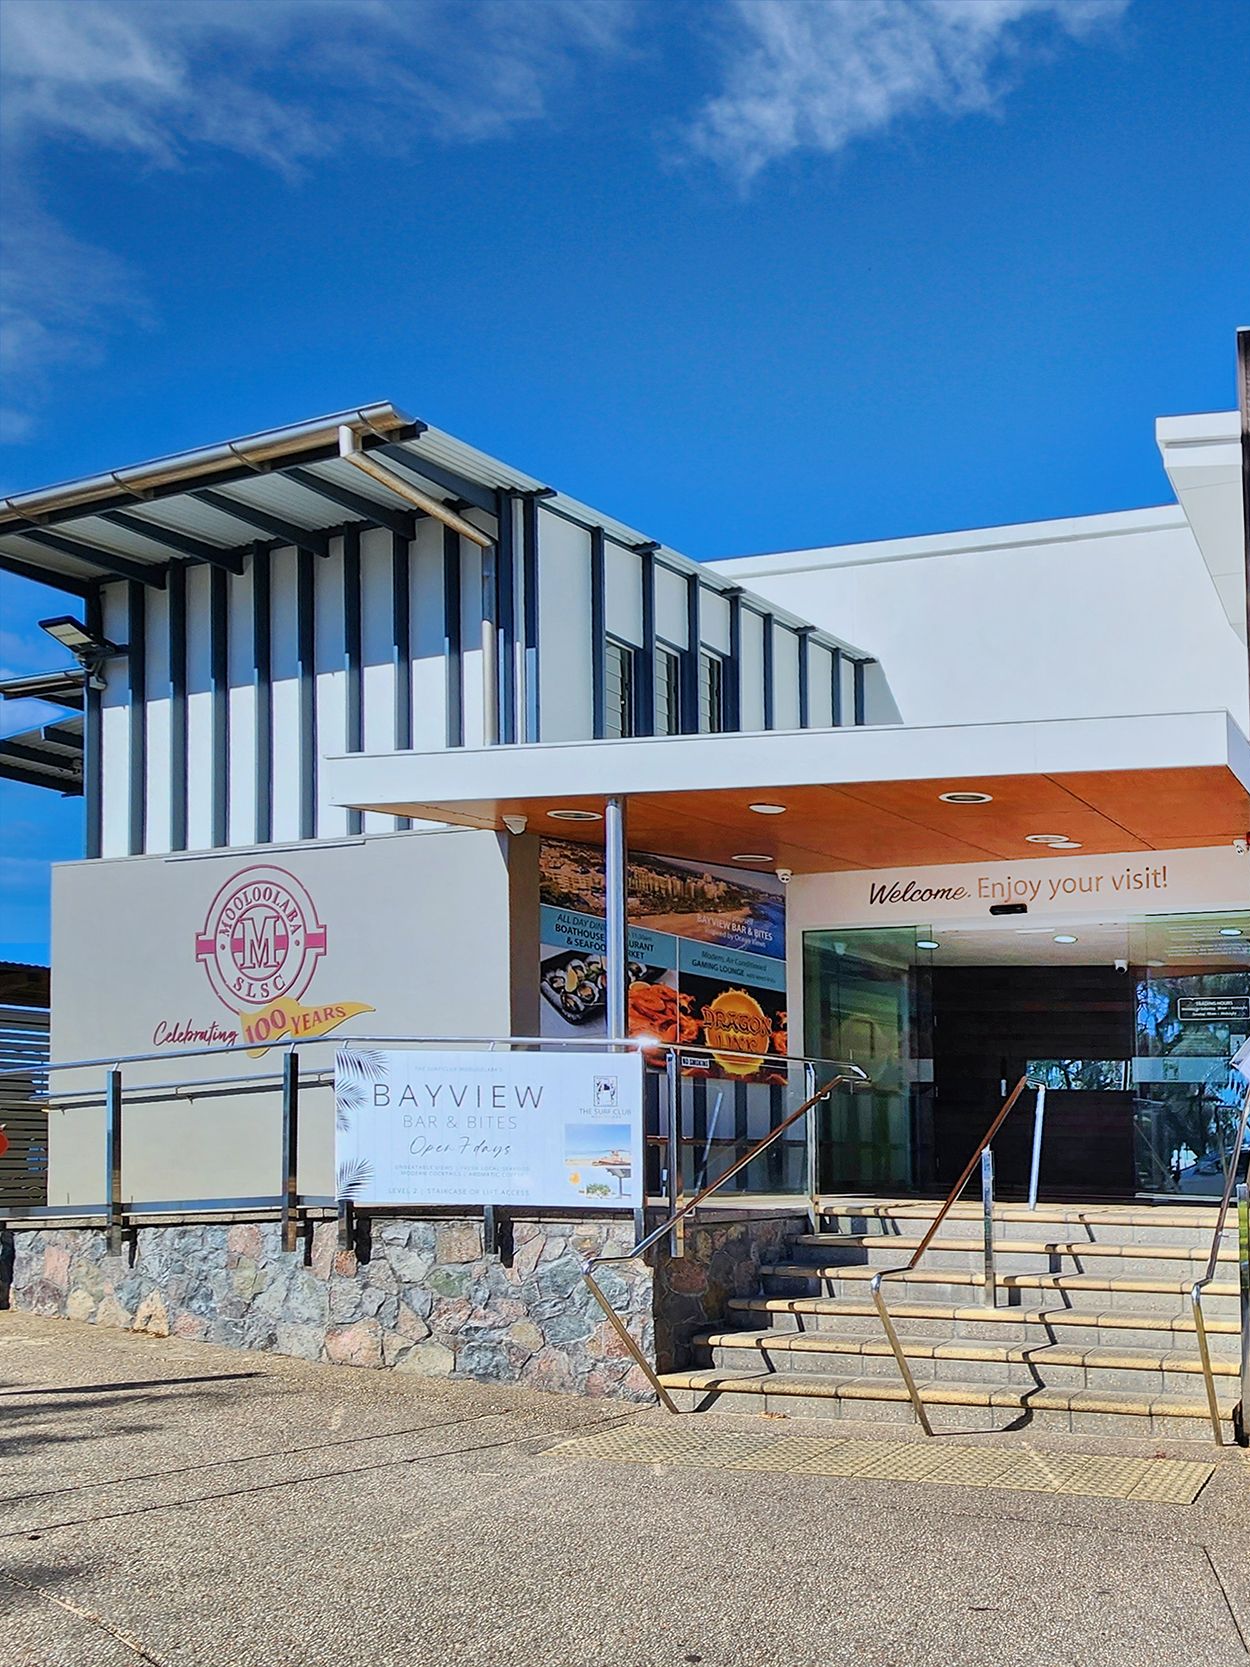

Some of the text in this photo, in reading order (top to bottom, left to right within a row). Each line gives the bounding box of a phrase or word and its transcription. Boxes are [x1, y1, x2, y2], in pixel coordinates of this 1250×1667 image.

[978, 876, 1041, 902] Enjoy
[1048, 875, 1103, 900] your
[1112, 866, 1167, 890] visit!
[218, 886, 303, 938] MOOLOOLABA
[555, 923, 605, 942] BOATHOUSE
[566, 937, 573, 945] &
[732, 923, 746, 935] BAR
[747, 928, 753, 936] &
[754, 929, 773, 941] BITES
[691, 959, 719, 972] GAMING
[233, 974, 286, 999] SLSC
[153, 1006, 347, 1047] Celebrating 100 YEARS
[701, 1005, 772, 1037] DRAGON
[374, 1084, 544, 1109] BAYVIEW
[403, 1114, 518, 1130] BAR & BITES
[409, 1135, 512, 1159] Open 7 days
